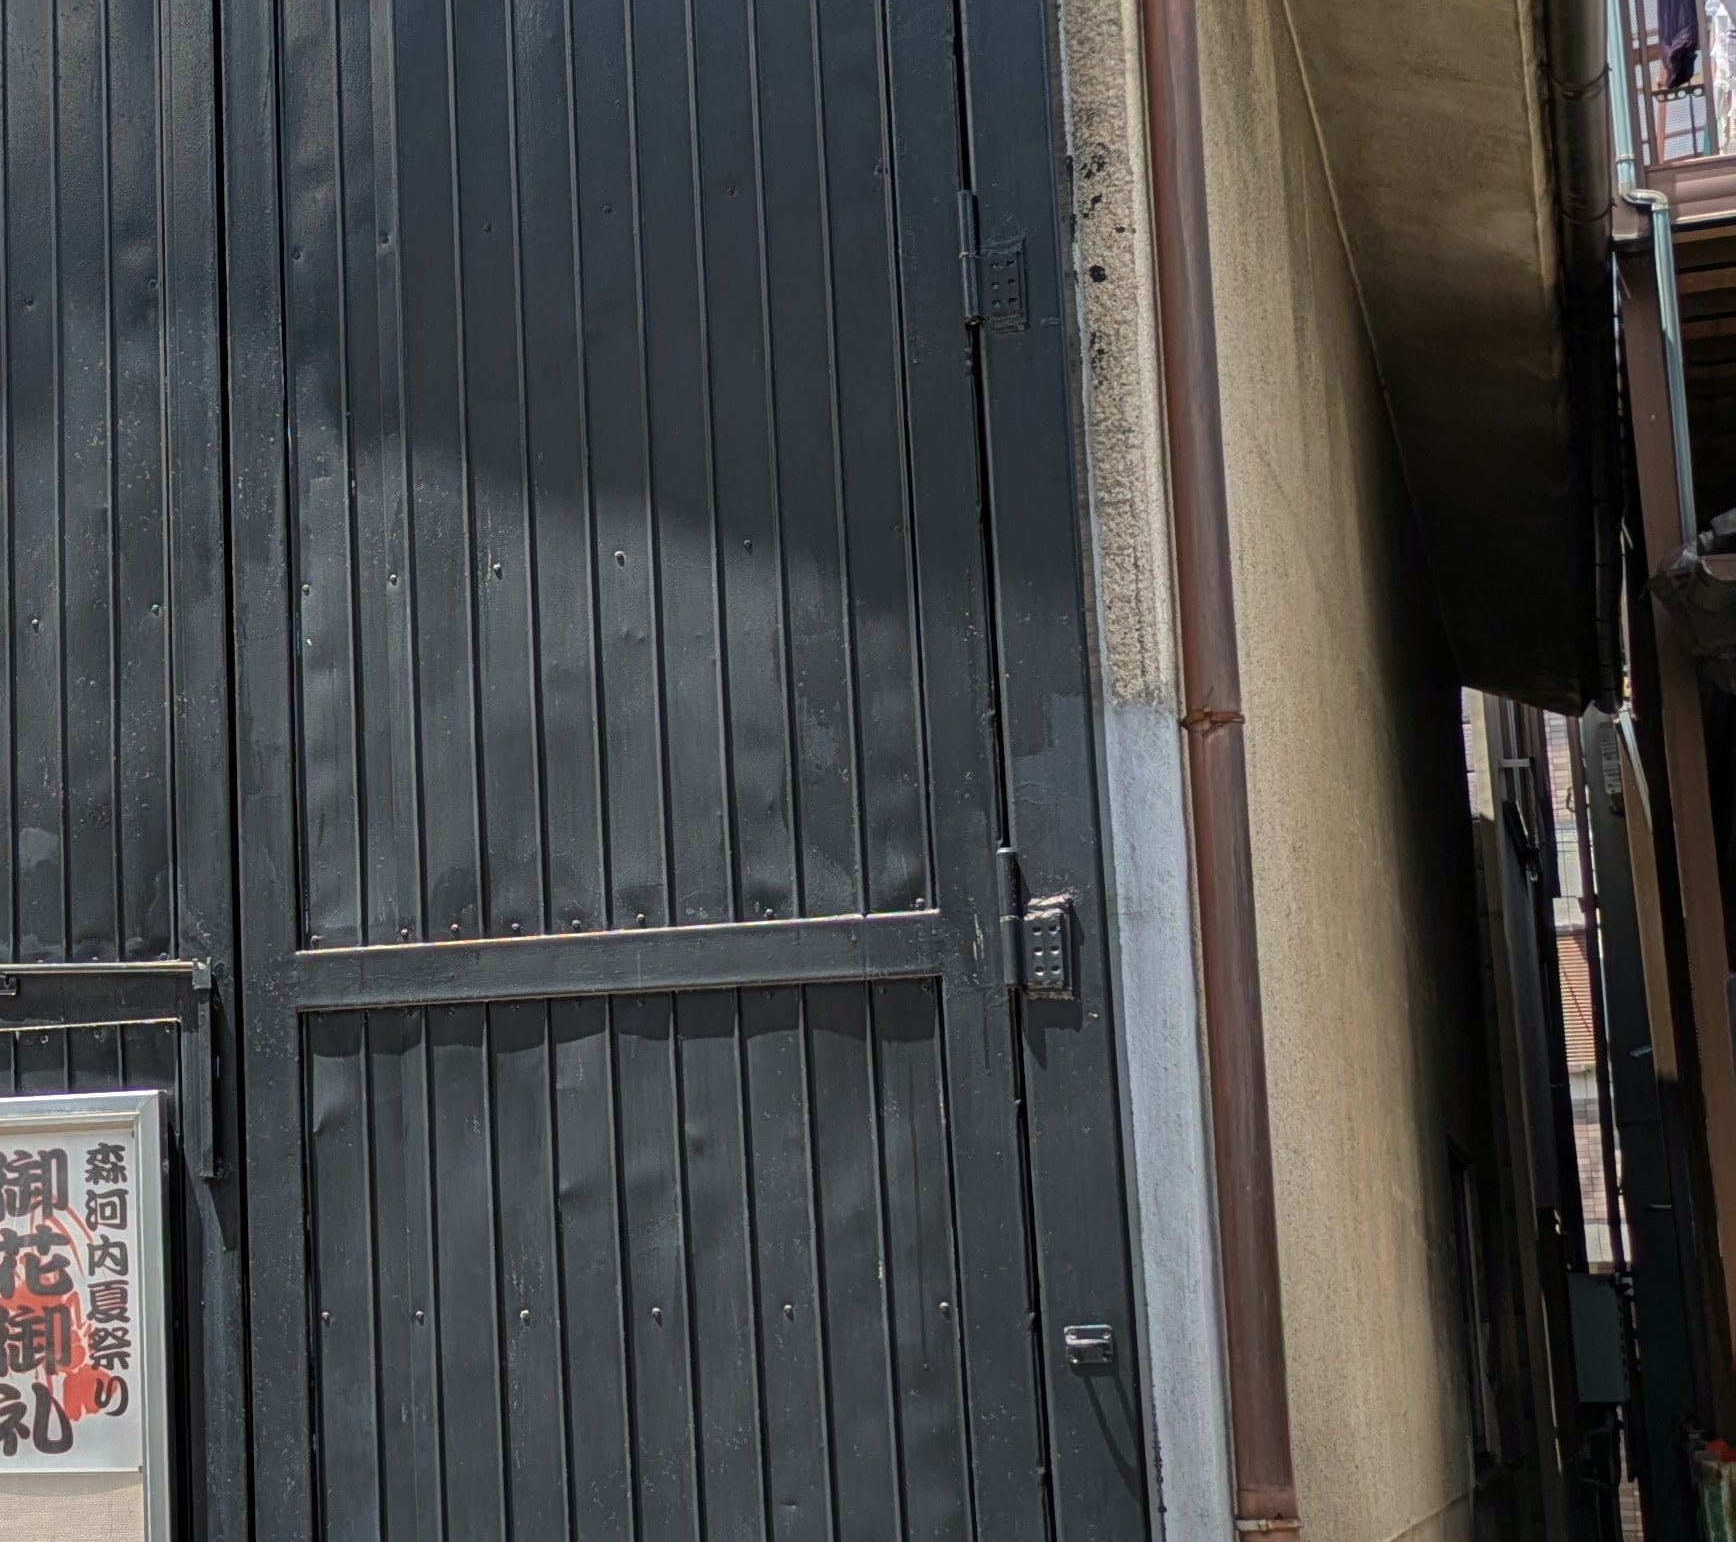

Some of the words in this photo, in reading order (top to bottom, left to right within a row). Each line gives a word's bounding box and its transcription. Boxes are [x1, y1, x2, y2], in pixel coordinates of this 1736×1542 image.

[85, 1142, 131, 1417] 森河内夏祭り
